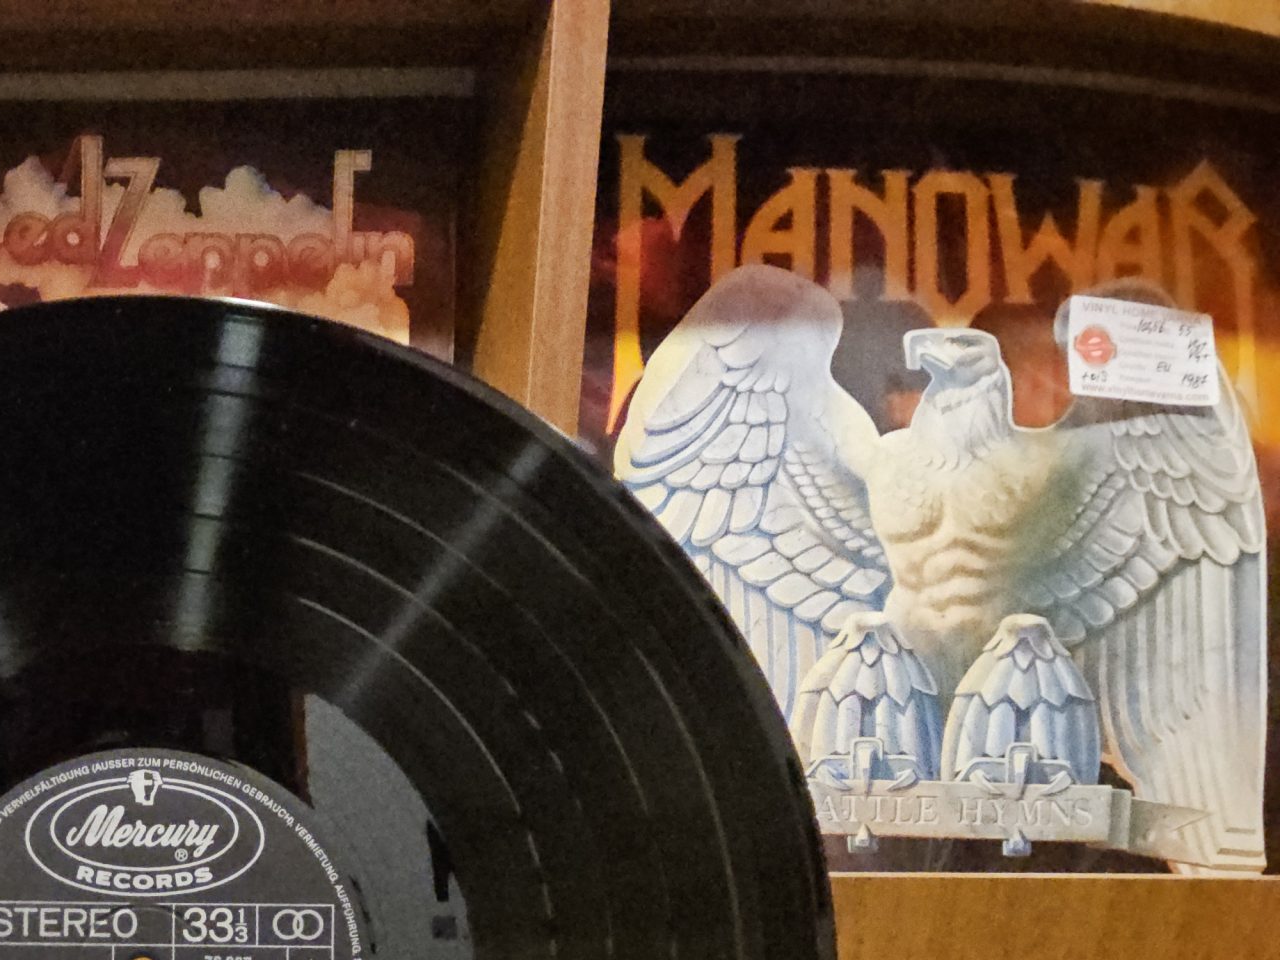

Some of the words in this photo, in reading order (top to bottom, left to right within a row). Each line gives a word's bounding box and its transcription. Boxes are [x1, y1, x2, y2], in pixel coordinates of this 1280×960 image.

[1082, 301, 1118, 315] VINYL
[0, 765, 91, 819] VERVIELFÄLTIGUNG
[91, 757, 136, 774] (AUSSER
[137, 757, 162, 768] ZUM
[162, 758, 243, 789] PERSÖNLICHEN
[959, 796, 1094, 829] HYMNS
[66, 804, 220, 858] Mercury
[76, 865, 214, 891] RECORDS
